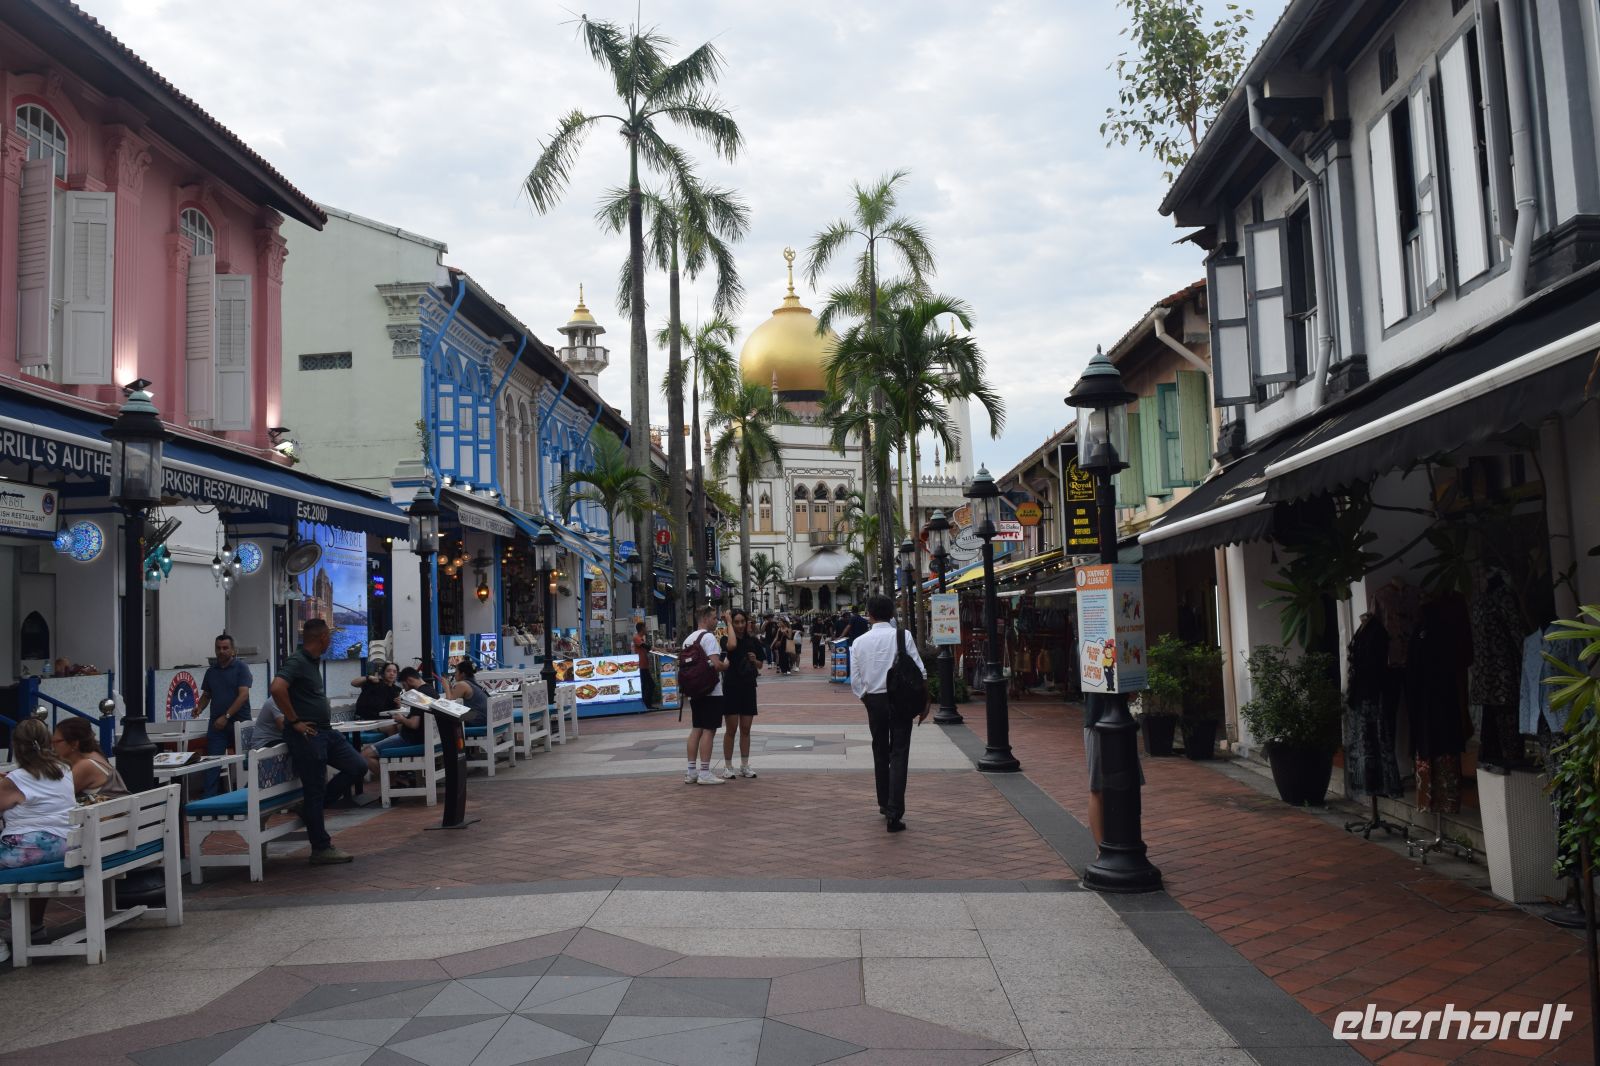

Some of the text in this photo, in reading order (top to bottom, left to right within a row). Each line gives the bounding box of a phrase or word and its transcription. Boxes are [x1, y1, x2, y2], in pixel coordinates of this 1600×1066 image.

[0, 430, 57, 465] RILL'S
[203, 479, 270, 510] RESTAURANT
[1070, 481, 1092, 490] Royal
[11, 512, 45, 522] RESTAURANT
